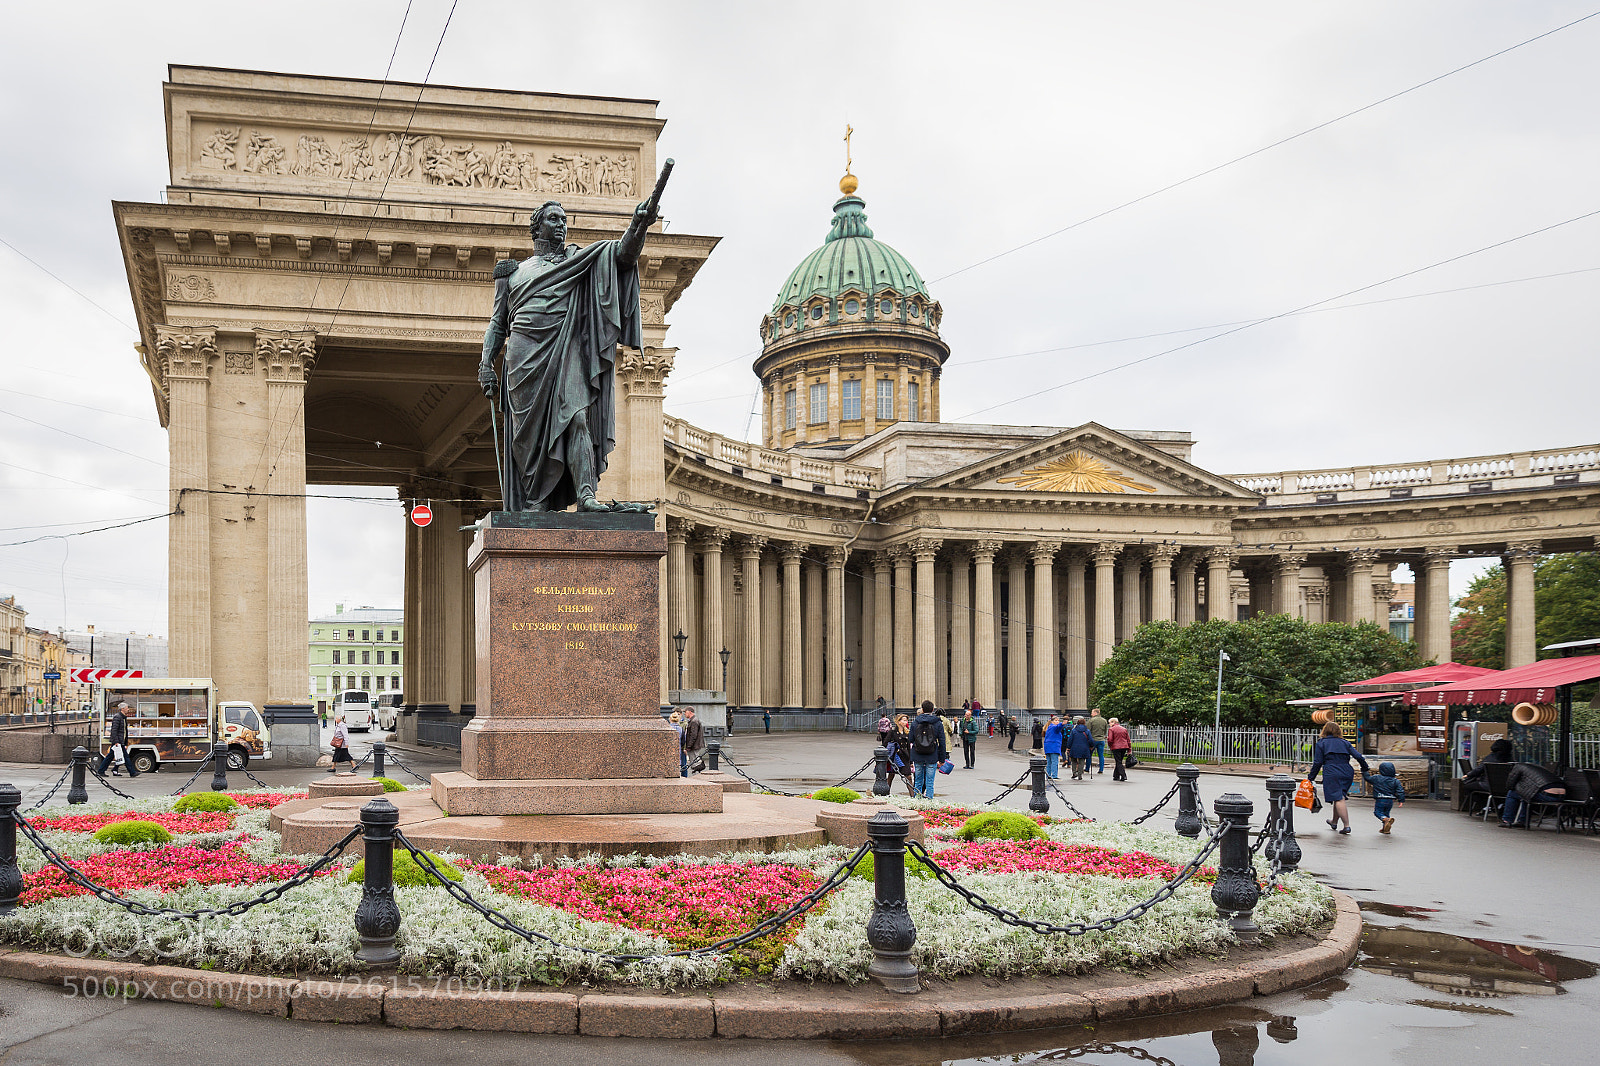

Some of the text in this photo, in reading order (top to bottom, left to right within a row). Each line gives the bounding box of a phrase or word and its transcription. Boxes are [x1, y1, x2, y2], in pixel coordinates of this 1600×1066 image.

[533, 586, 617, 596] ФЕЛЬДМАРШАЛУ
[557, 604, 594, 613] КНЯЗЮ
[511, 622, 639, 632] КУТУЗОВУ СМОЛЕНСКОМУ
